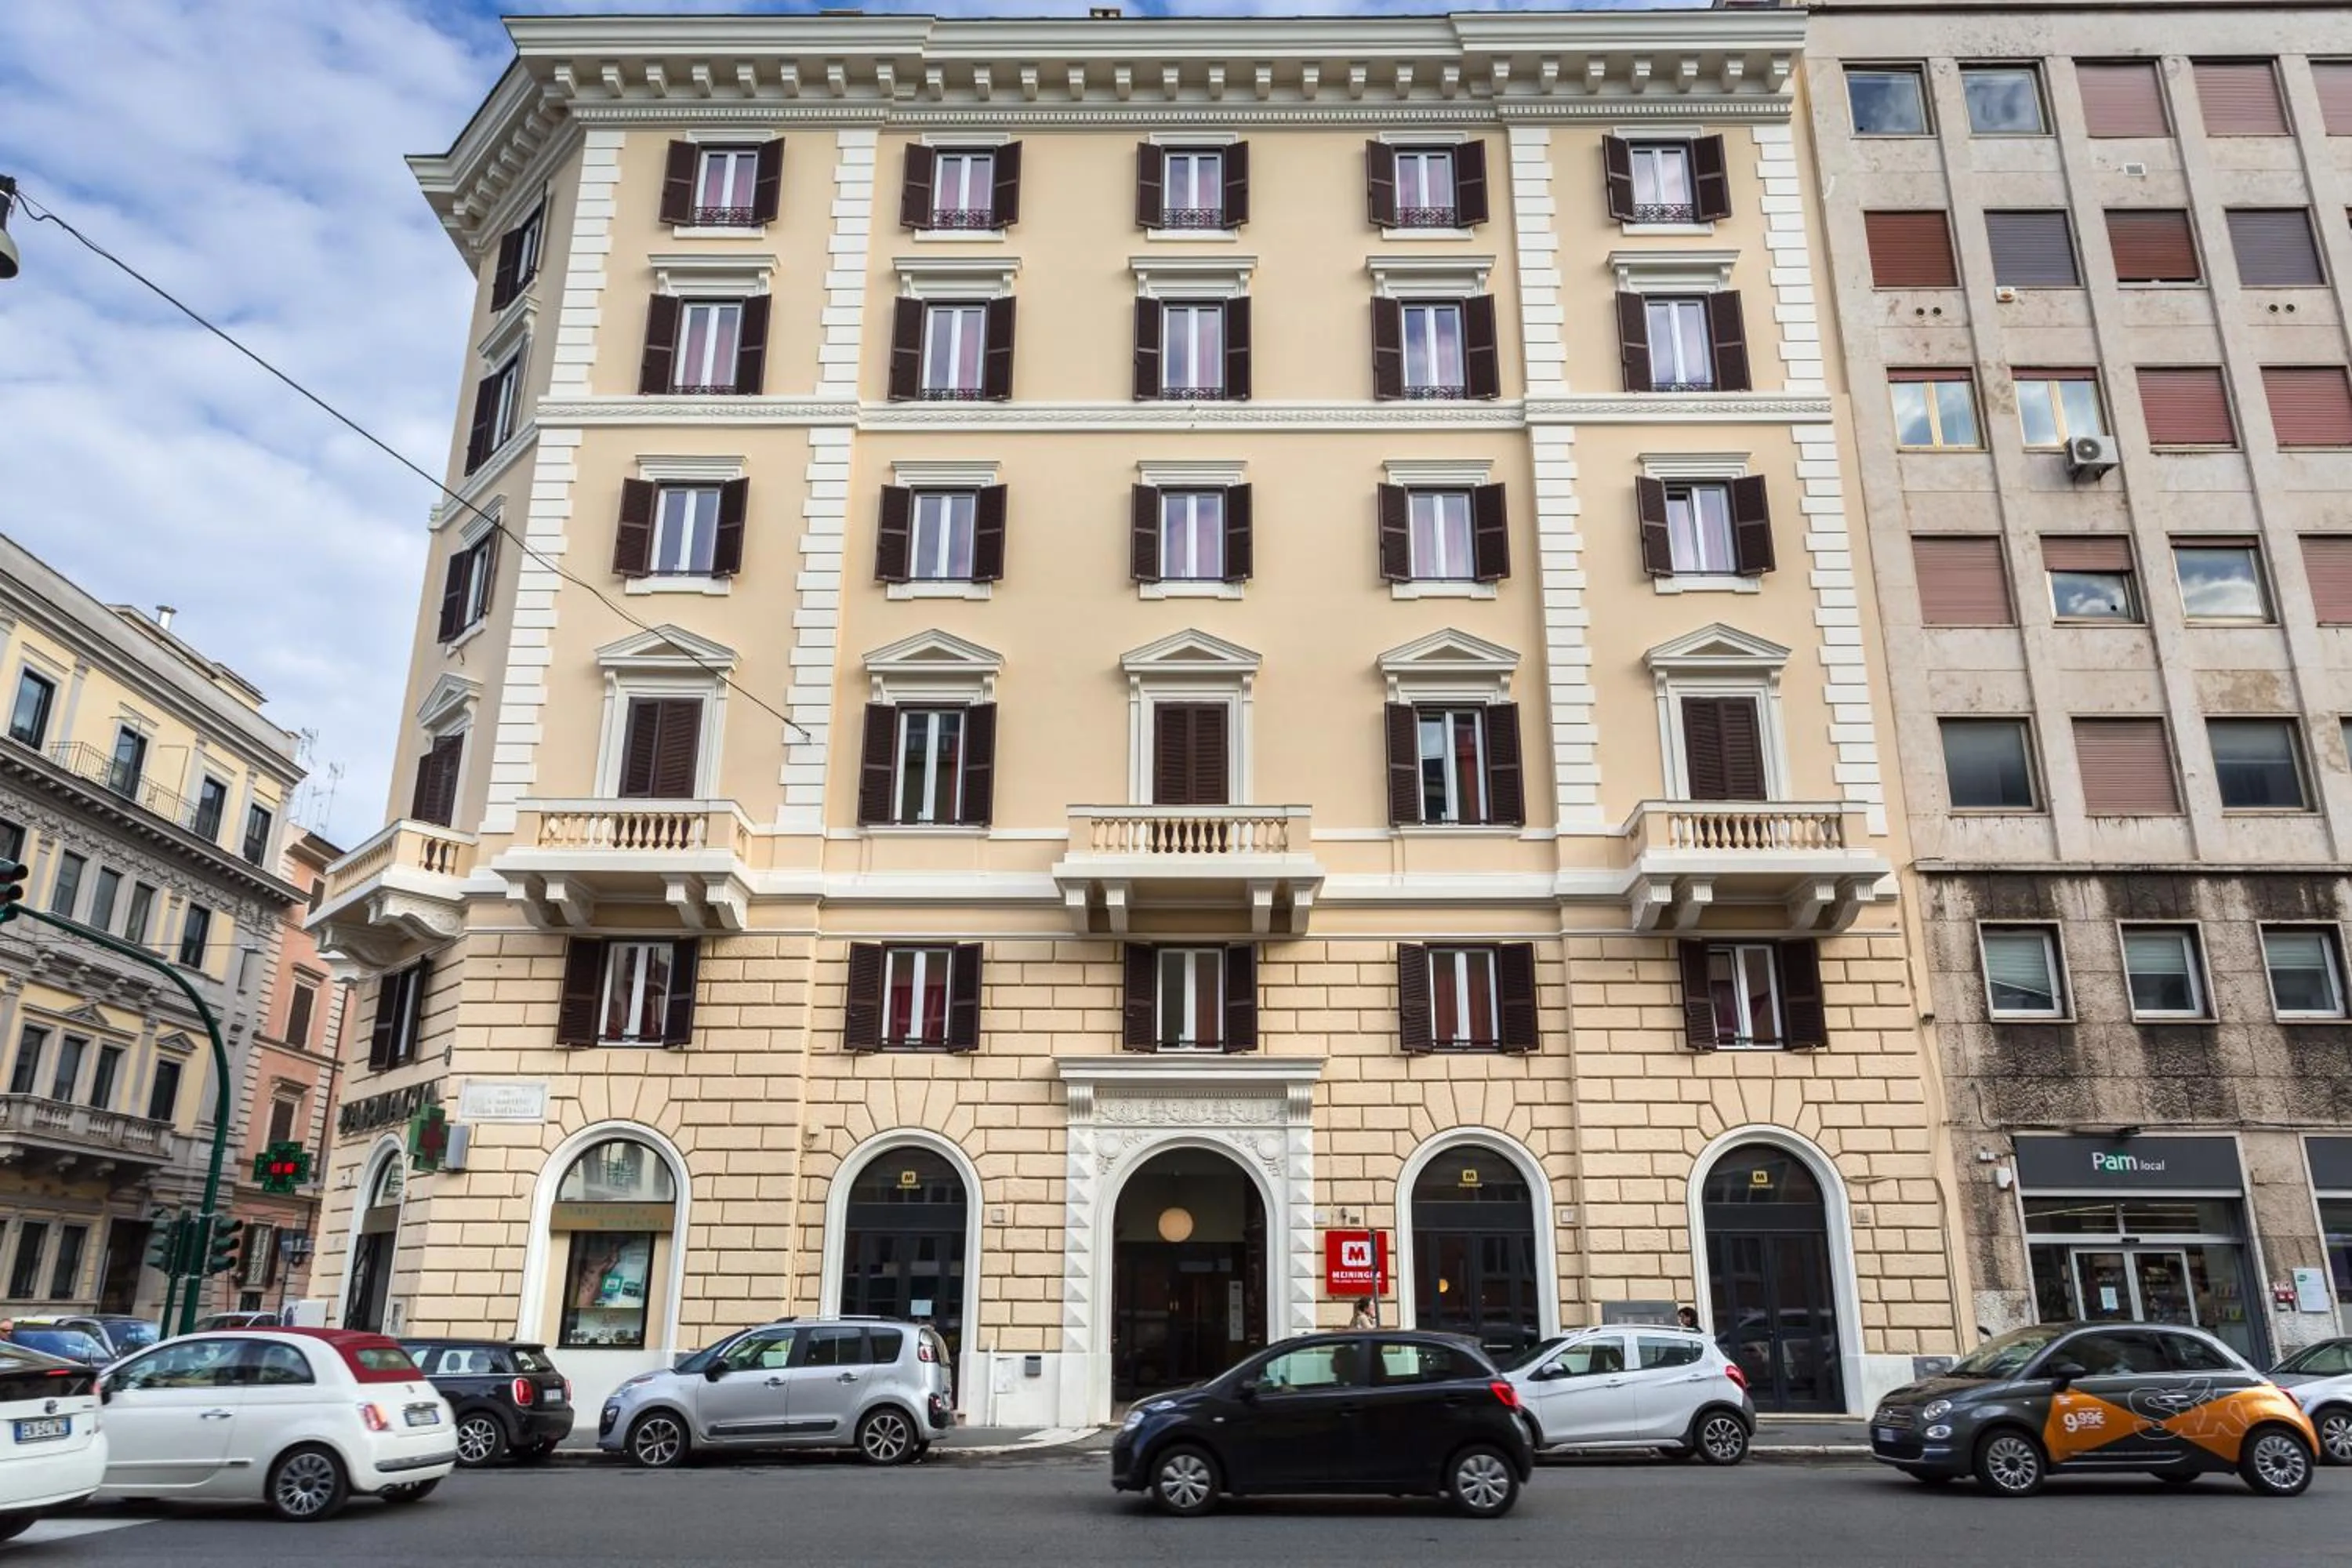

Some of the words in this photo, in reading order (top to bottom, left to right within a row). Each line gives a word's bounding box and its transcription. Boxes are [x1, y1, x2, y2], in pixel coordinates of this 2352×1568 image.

[2092, 1152, 2138, 1171] Pam
[2140, 1160, 2165, 1171] local
[1348, 1246, 1366, 1261] M
